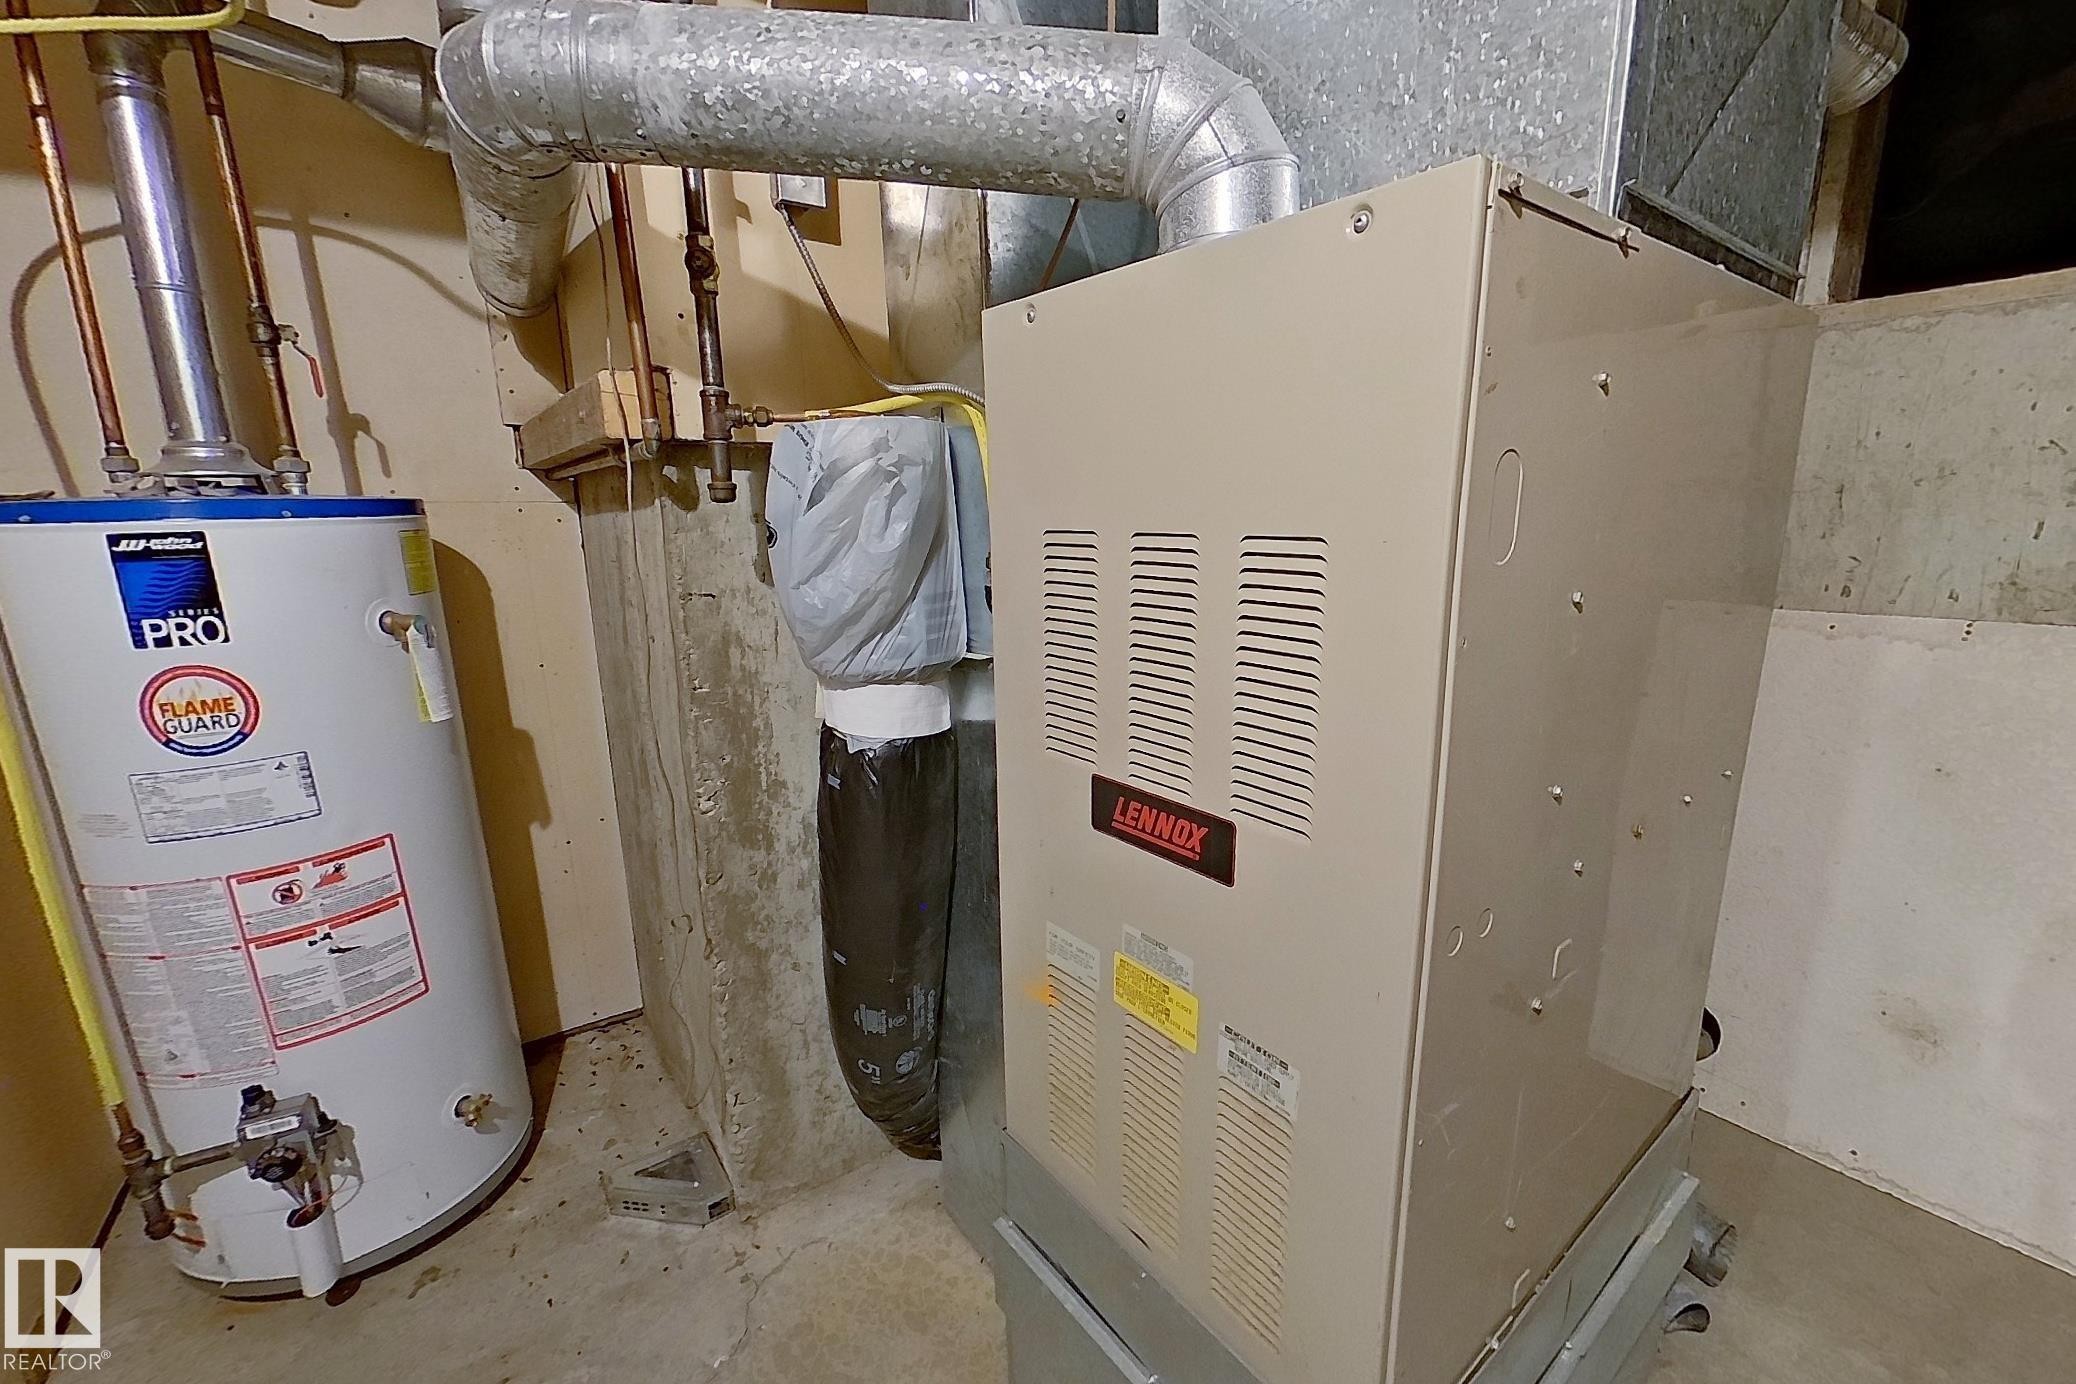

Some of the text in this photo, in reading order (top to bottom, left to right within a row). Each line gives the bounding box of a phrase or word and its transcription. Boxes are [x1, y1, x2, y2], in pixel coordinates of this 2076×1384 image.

[141, 615, 226, 648] PRO
[158, 698, 236, 719] FLAME
[162, 712, 242, 736] GUARD
[1112, 796, 1209, 853] LENNOX
